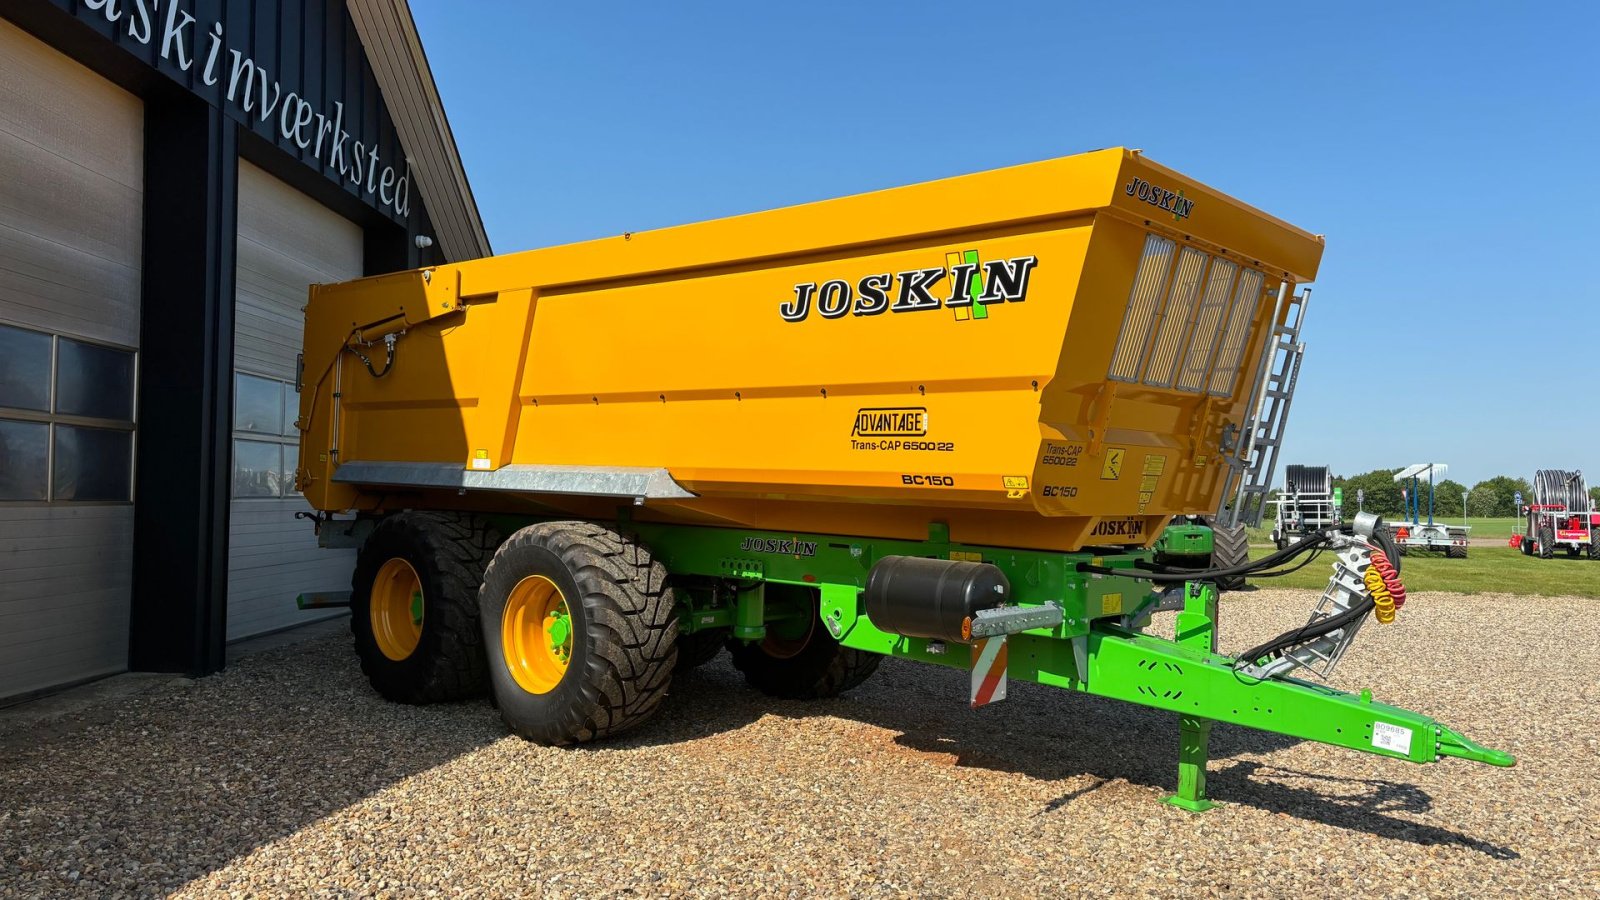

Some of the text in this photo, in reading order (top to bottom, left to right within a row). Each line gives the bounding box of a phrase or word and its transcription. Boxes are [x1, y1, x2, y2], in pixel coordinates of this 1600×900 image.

[1126, 176, 1194, 218] JOSKIN
[779, 255, 1038, 322] JOSKIN
[851, 413, 922, 437] ADVANTAGE
[851, 440, 954, 451] Trans-CAP 6500 22
[1047, 443, 1083, 456] Trans-CAP
[1043, 456, 1065, 465] 6500
[902, 475, 954, 487] BC150
[1043, 485, 1078, 497] BC150
[1090, 520, 1144, 536] JOSKIN
[741, 537, 816, 556] JOSKIN
